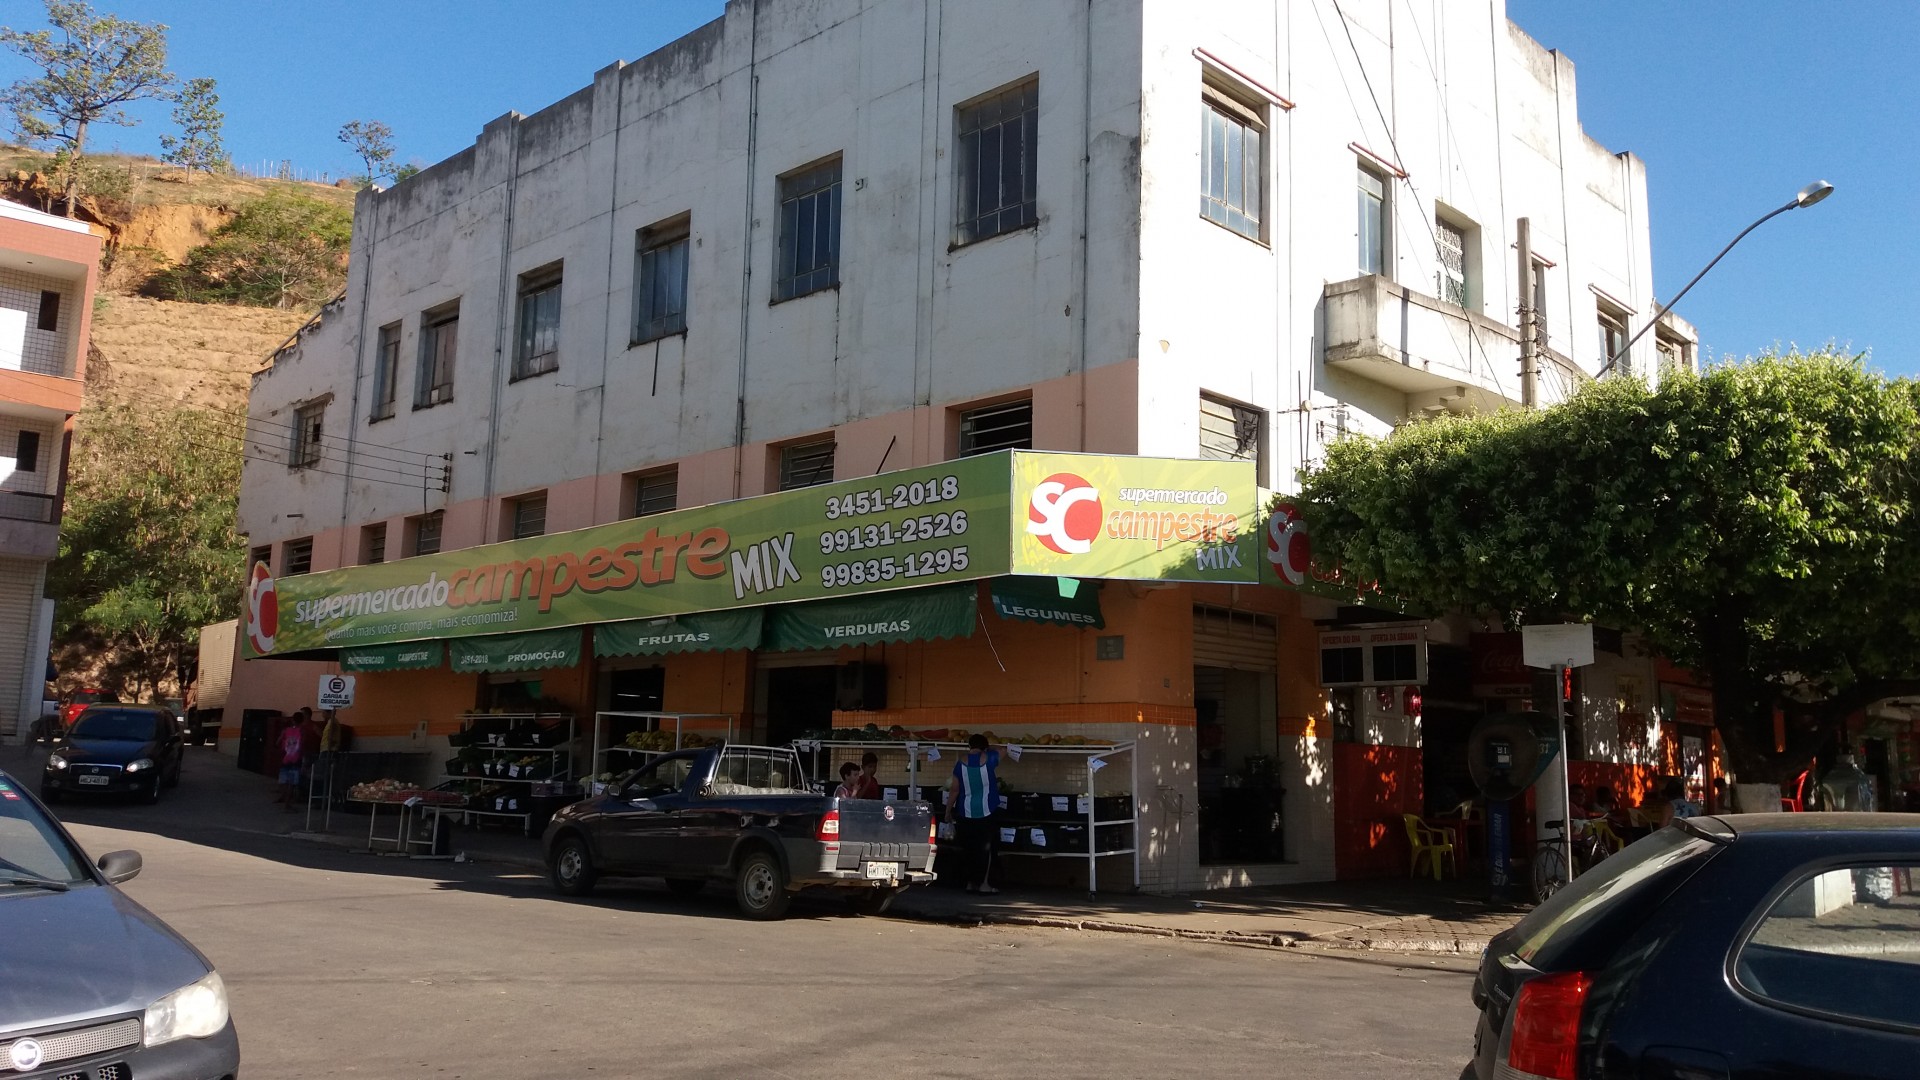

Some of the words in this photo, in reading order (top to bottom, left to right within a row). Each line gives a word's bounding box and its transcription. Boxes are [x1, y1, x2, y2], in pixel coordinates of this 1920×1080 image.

[825, 475, 960, 520] 3451-2018
[1119, 486, 1228, 506] supermercado
[820, 510, 969, 554] 99131-2526
[1106, 506, 1239, 551] campestre
[820, 546, 969, 588] 99835-1295
[1195, 545, 1242, 571] MIX
[295, 571, 448, 628] supermercado
[448, 527, 731, 614] campestre
[730, 532, 802, 600] MIX
[325, 628, 354, 642] Quanto
[356, 628, 376, 637] mais
[377, 623, 397, 635] você
[437, 616, 458, 629] mais
[461, 607, 518, 628] economiza!
[1002, 604, 1096, 624] LEGUMES
[638, 632, 710, 646] FRUTAS
[824, 620, 911, 638] VERDURAS
[347, 656, 385, 665] SUPERMERCADO
[397, 652, 428, 662] CAMPESTRE
[507, 650, 565, 663] PROMOÇÃO
